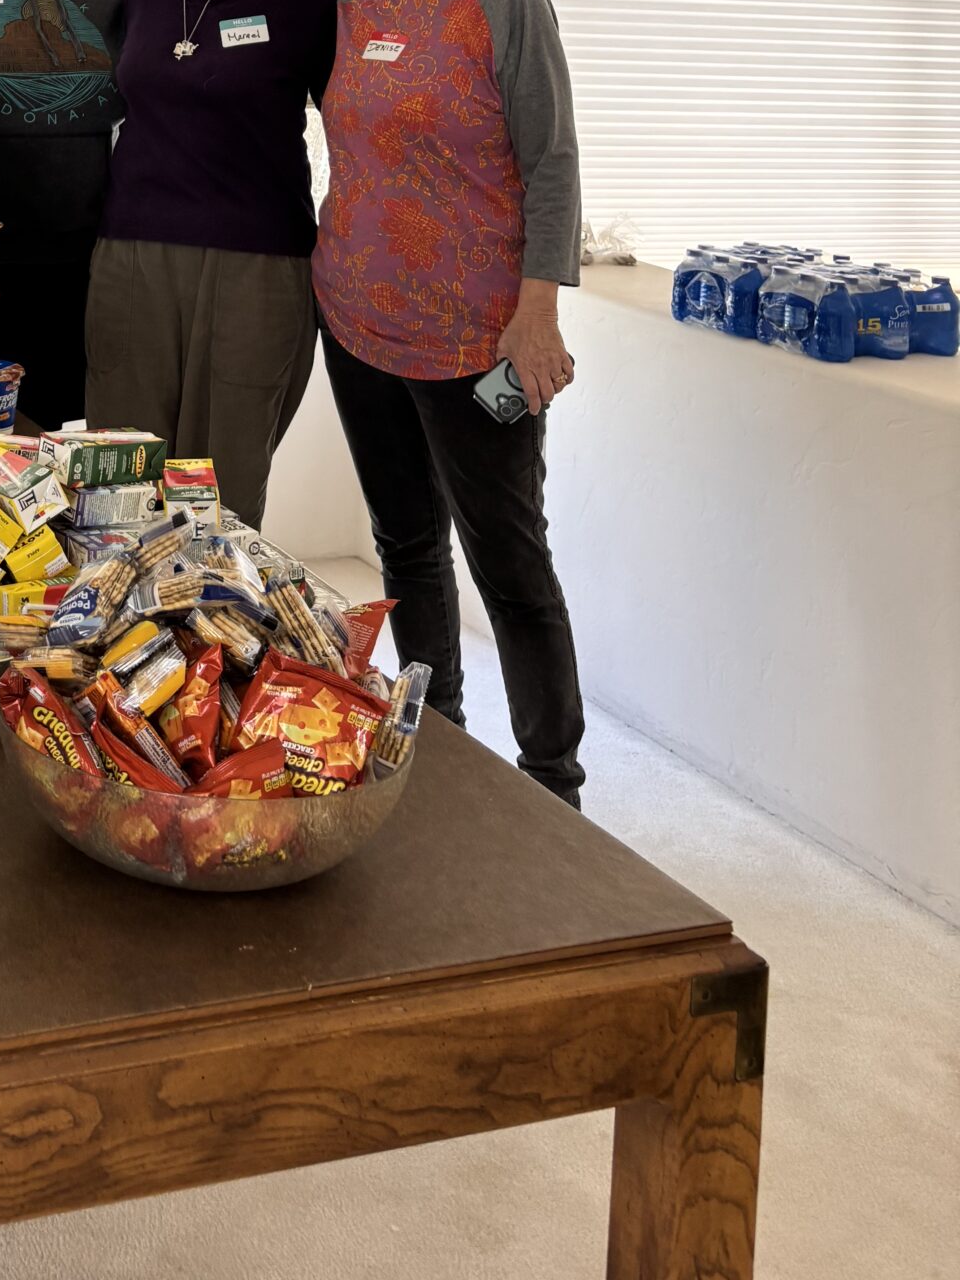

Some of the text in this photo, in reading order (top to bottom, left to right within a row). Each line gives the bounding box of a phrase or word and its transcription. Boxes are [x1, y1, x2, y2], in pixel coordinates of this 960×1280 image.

[232, 18, 253, 26] HELLO
[368, 42, 402, 53] DENISE
[97, 81, 118, 107] AZ
[857, 318, 881, 332] 15
[26, 548, 40, 559] APPLE
[282, 740, 316, 756] CRACKER
